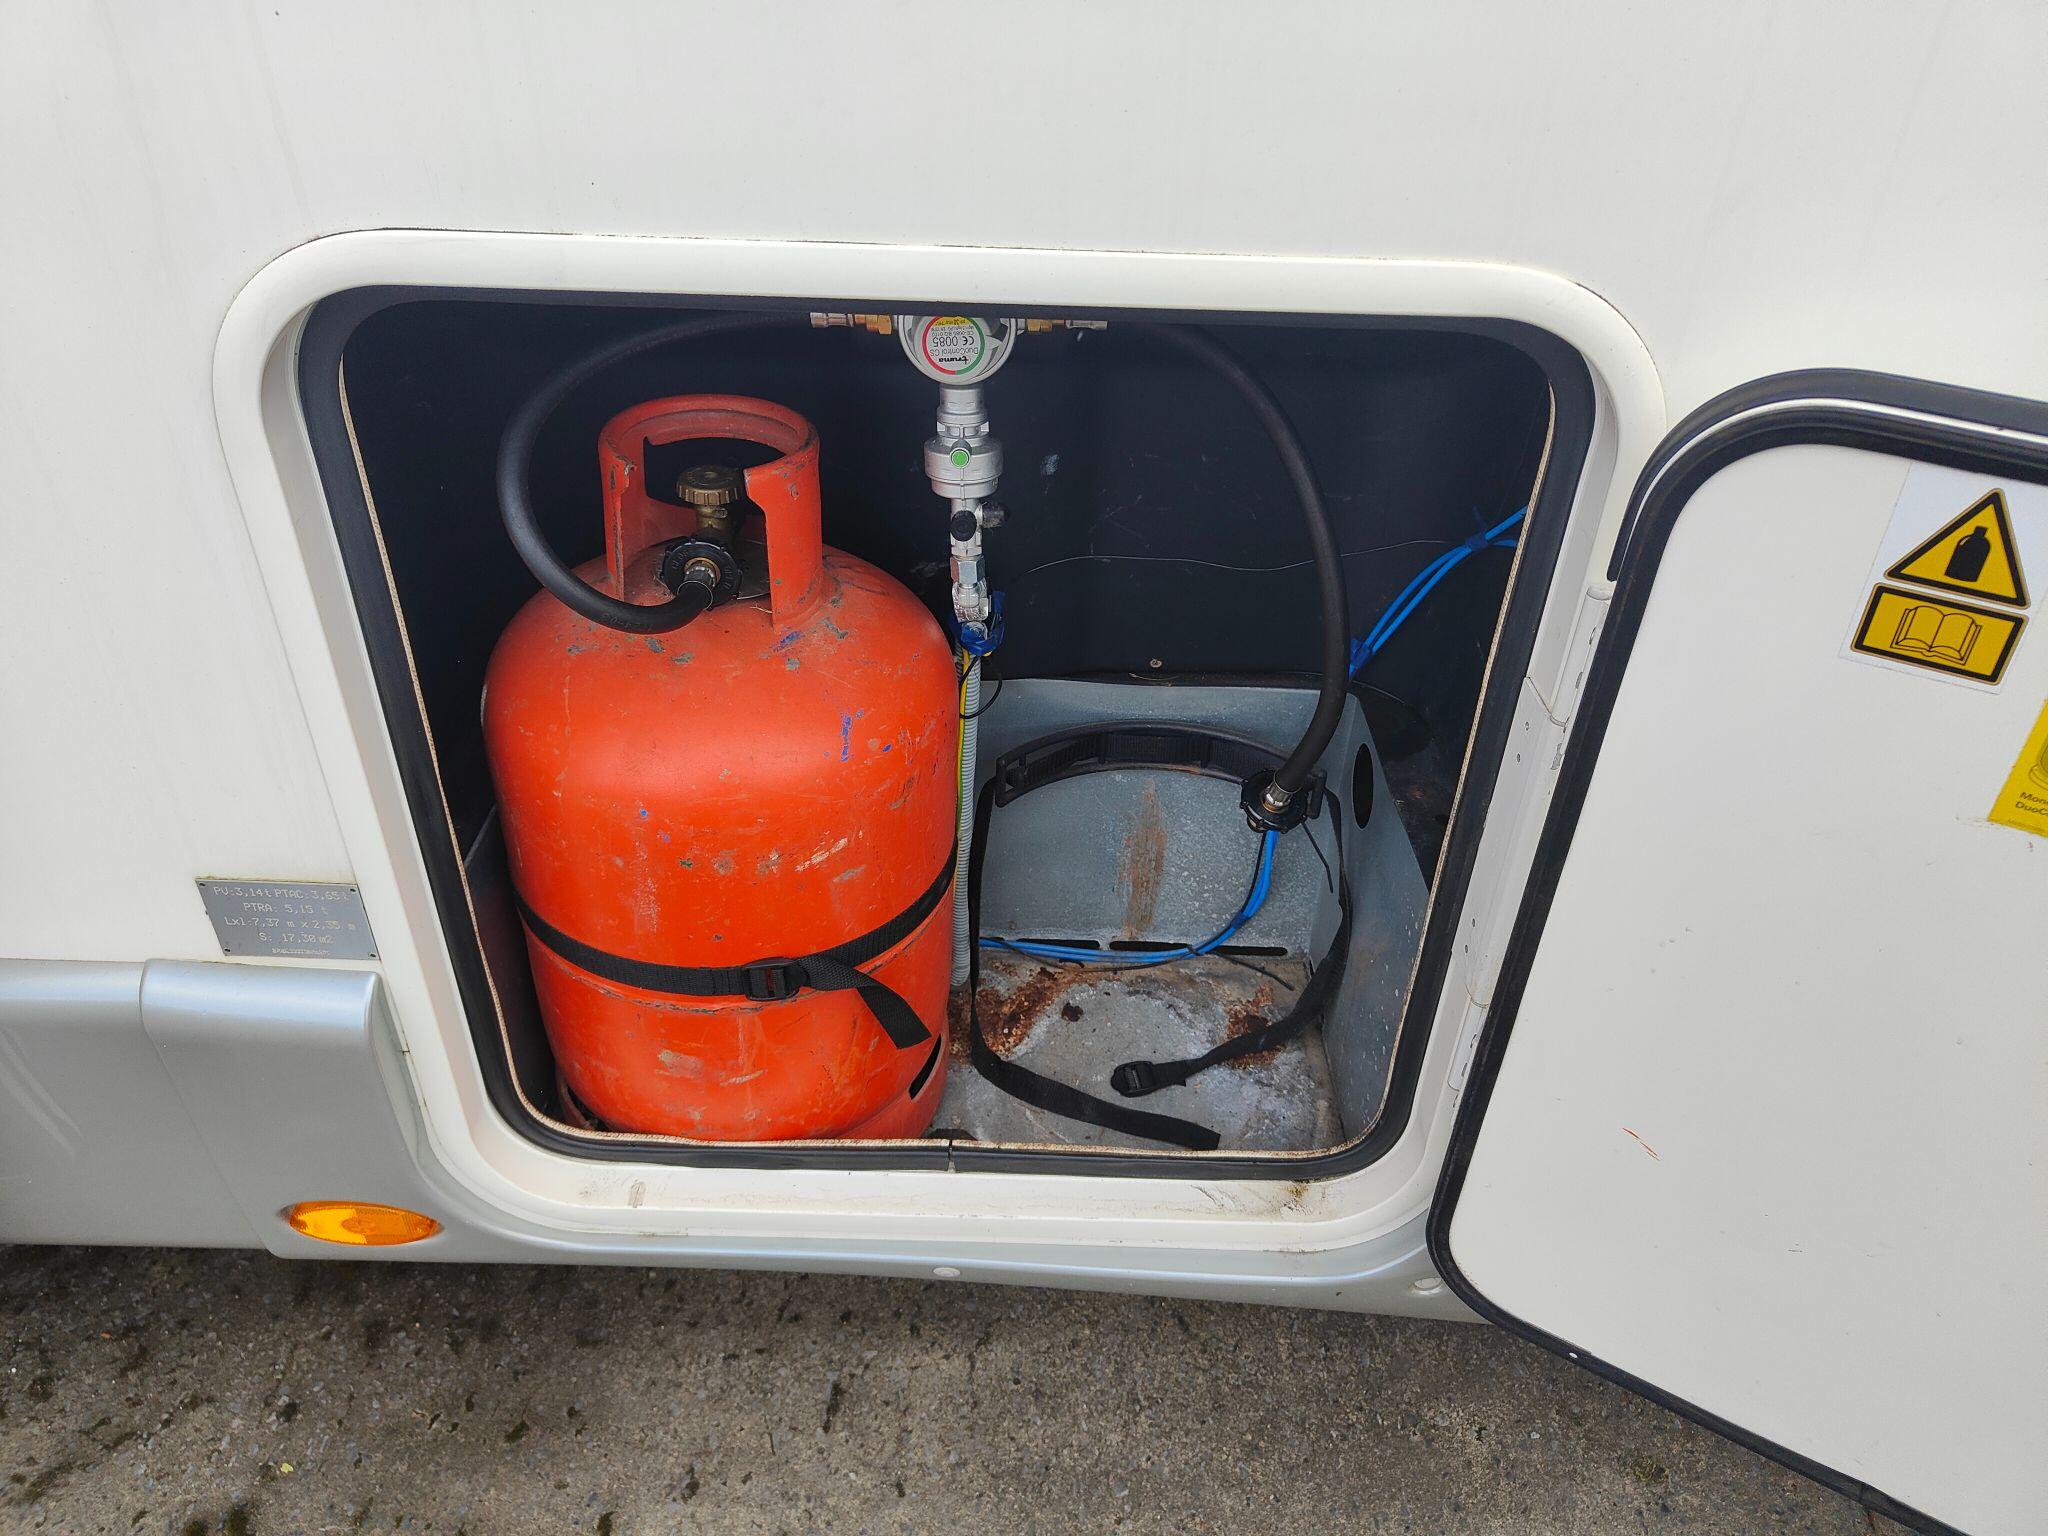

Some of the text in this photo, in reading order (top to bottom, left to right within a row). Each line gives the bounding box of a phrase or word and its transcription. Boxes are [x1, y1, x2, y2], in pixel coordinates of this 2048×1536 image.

[932, 336, 958, 348] 0085
[938, 356, 968, 364] truma
[2015, 801, 2048, 816] DuoC
[287, 920, 296, 928] m
